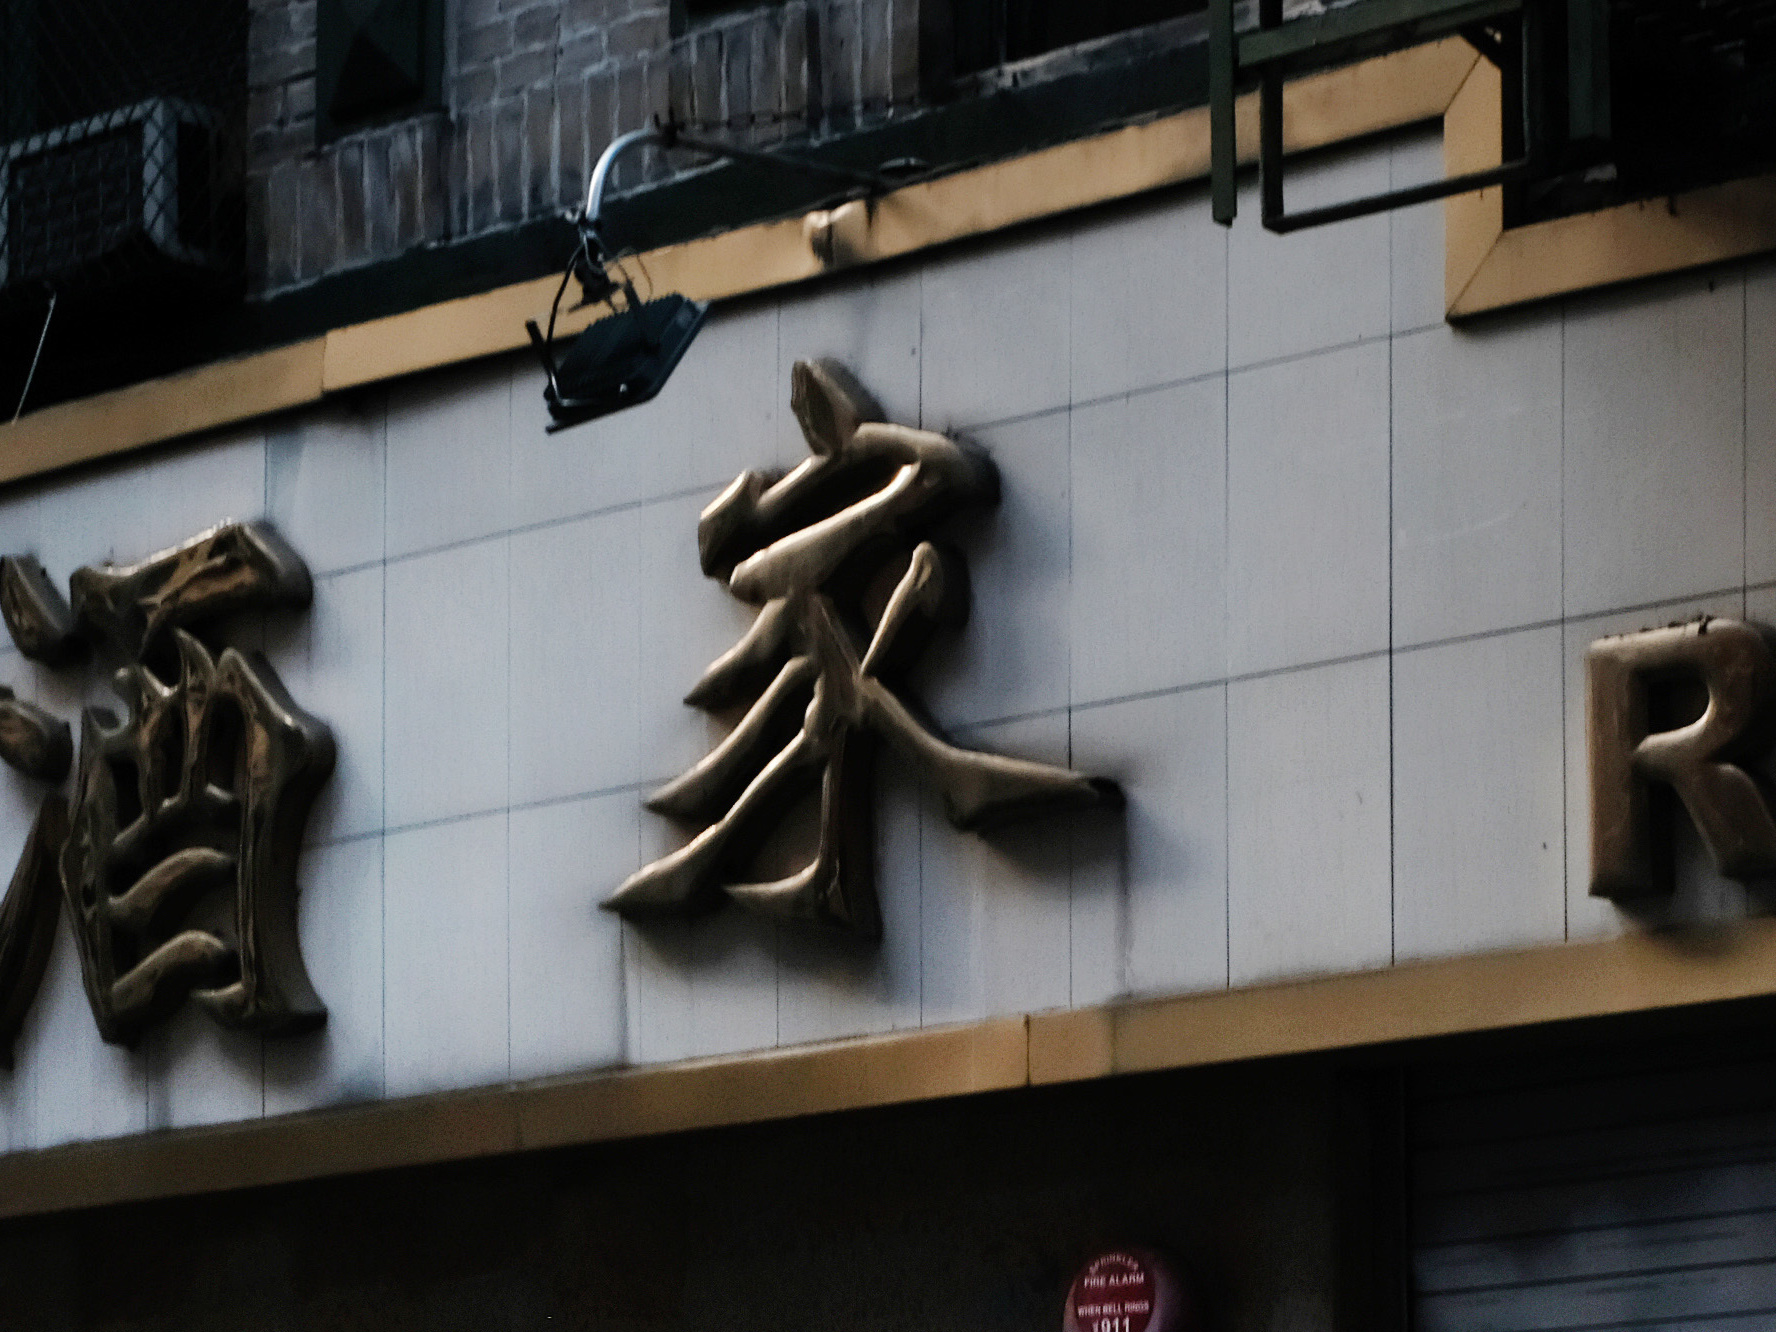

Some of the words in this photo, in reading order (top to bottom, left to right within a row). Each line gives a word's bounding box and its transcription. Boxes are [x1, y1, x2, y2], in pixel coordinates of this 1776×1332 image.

[1084, 1275, 1106, 1289] FIRE
[1109, 1271, 1144, 1287] ALARM
[1078, 1304, 1101, 1317] WHEN
[1102, 1302, 1122, 1315] BELL
